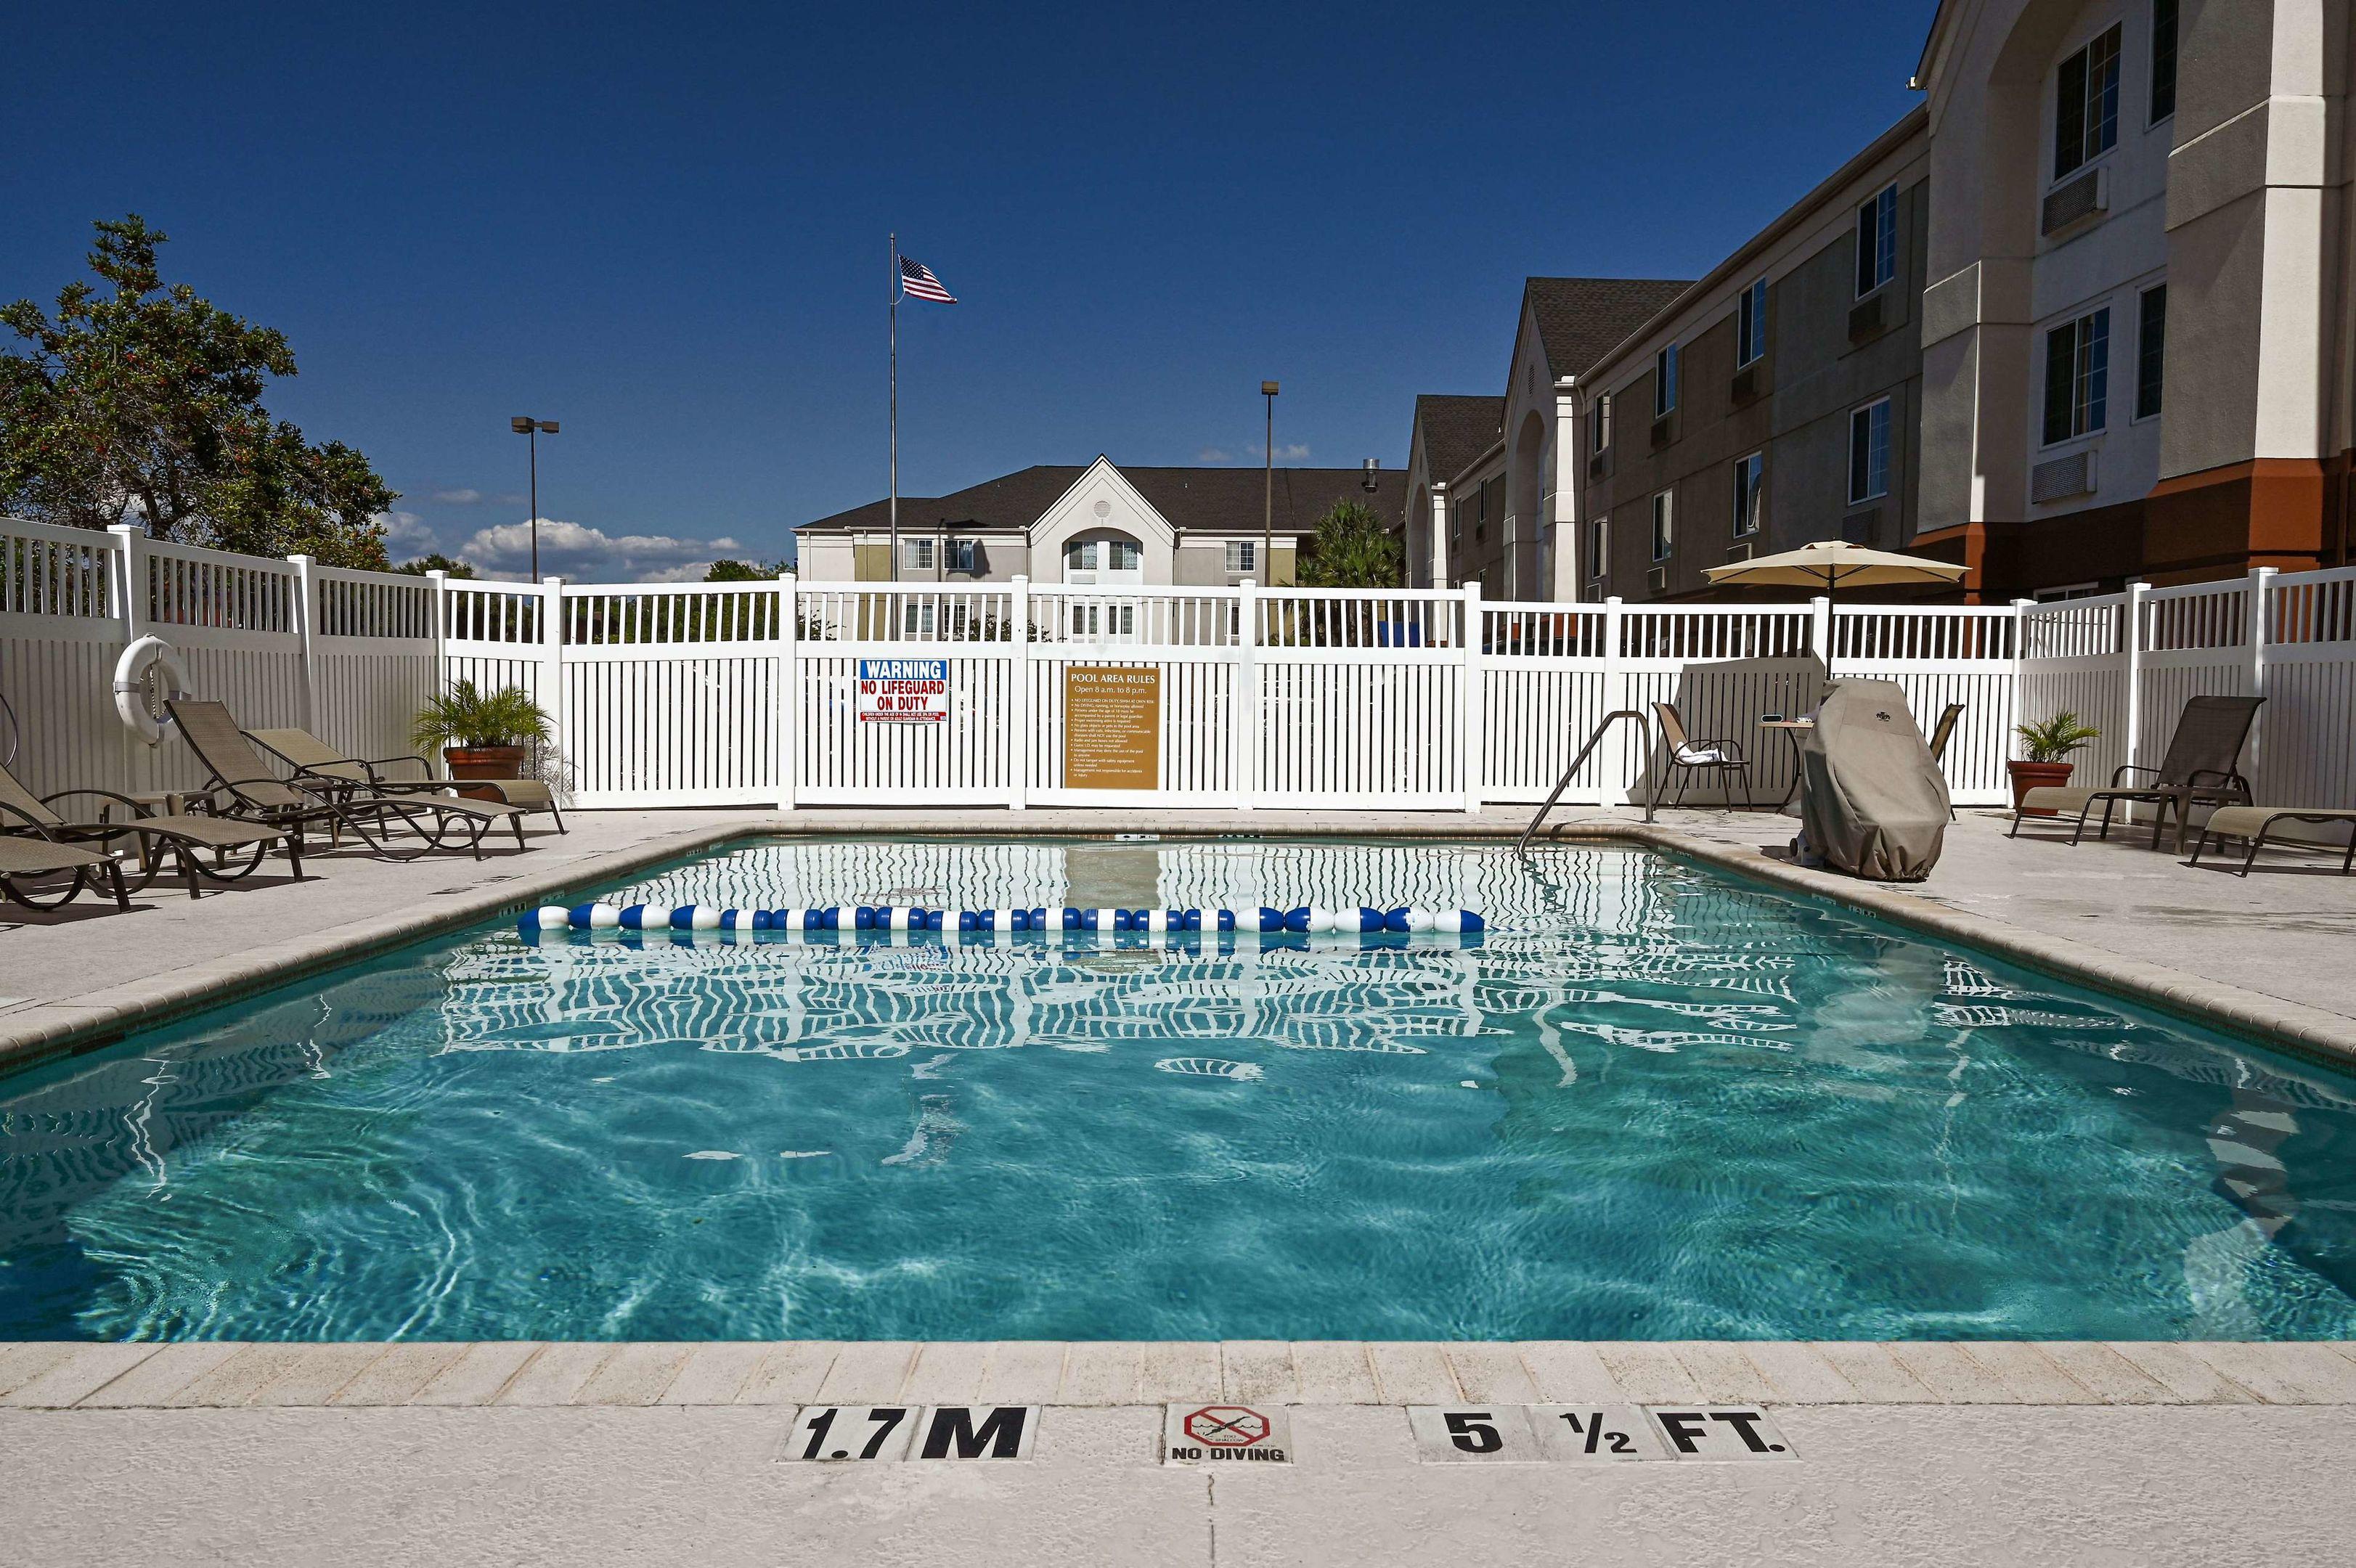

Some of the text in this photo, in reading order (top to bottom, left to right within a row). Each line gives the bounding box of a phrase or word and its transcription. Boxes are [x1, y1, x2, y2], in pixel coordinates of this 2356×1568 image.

[866, 661, 941, 679] WARNING
[1071, 674, 1098, 682] POOL
[861, 681, 944, 694] NO LIFEGUARD
[877, 696, 928, 710] ON DUTY
[802, 1408, 1027, 1459] 1.7 M
[1443, 1413, 1503, 1453] 5
[1655, 1412, 1785, 1453] FT.
[1172, 1448, 1284, 1461] NO DIVING
